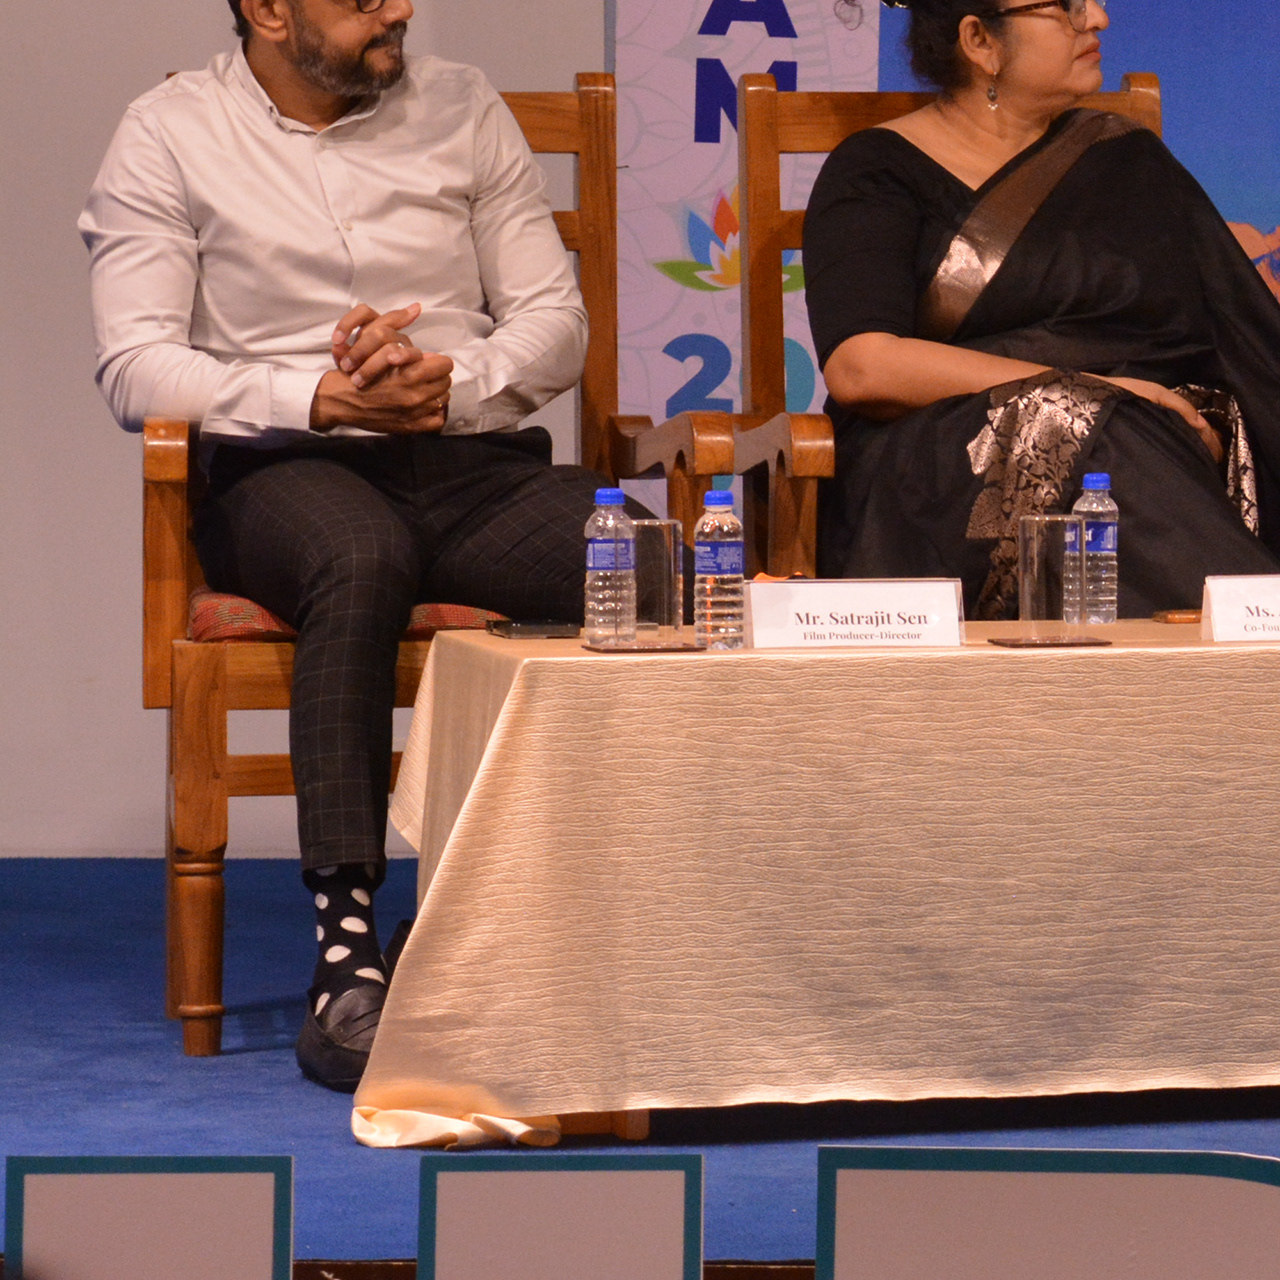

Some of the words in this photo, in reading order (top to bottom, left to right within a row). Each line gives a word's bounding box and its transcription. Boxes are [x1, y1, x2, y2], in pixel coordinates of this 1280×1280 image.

[1246, 606, 1274, 617] Ms.
[796, 613, 823, 625] Mr.
[829, 611, 891, 627] Satrajit
[897, 612, 927, 624] Sen
[804, 632, 826, 640] Film
[829, 631, 921, 639] Producer-Director
